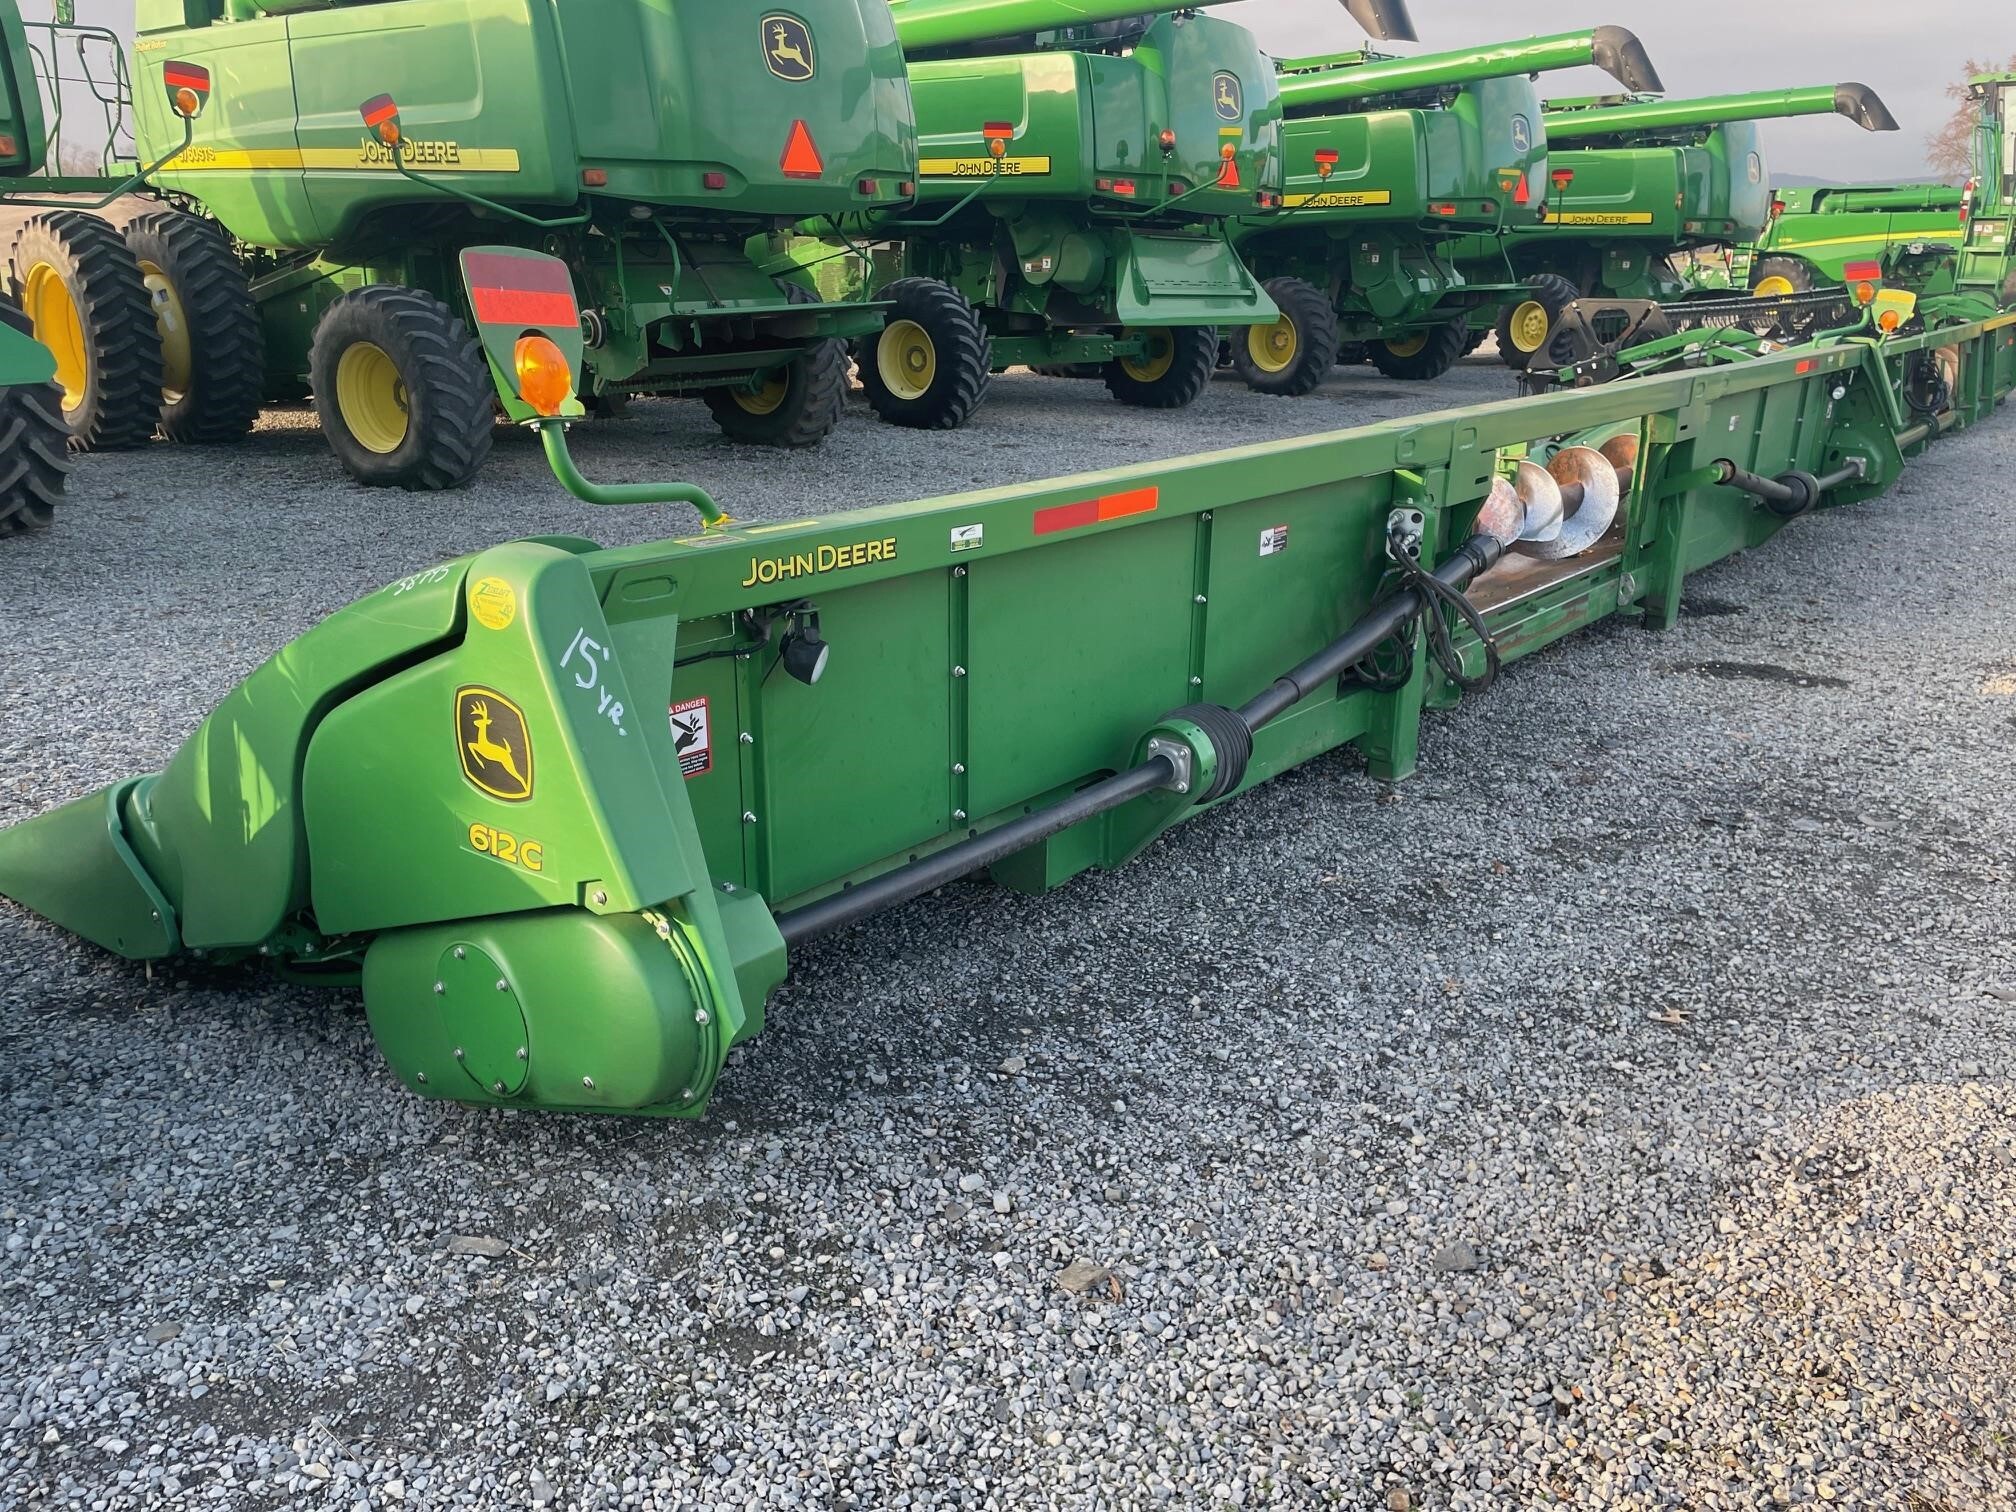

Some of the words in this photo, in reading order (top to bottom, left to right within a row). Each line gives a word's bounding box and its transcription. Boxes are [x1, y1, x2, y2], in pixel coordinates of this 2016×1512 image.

[400, 137, 460, 163] DEERE
[952, 161, 982, 175] JOHN
[983, 160, 1021, 174] DEERE
[1329, 195, 1364, 206] DEERE
[1569, 215, 1595, 224] JOHN
[1596, 214, 1629, 223] DEERE
[742, 552, 816, 588] JOHN
[816, 537, 897, 573] DEERE
[675, 698, 706, 714] DANGER
[468, 822, 543, 872] 612C
